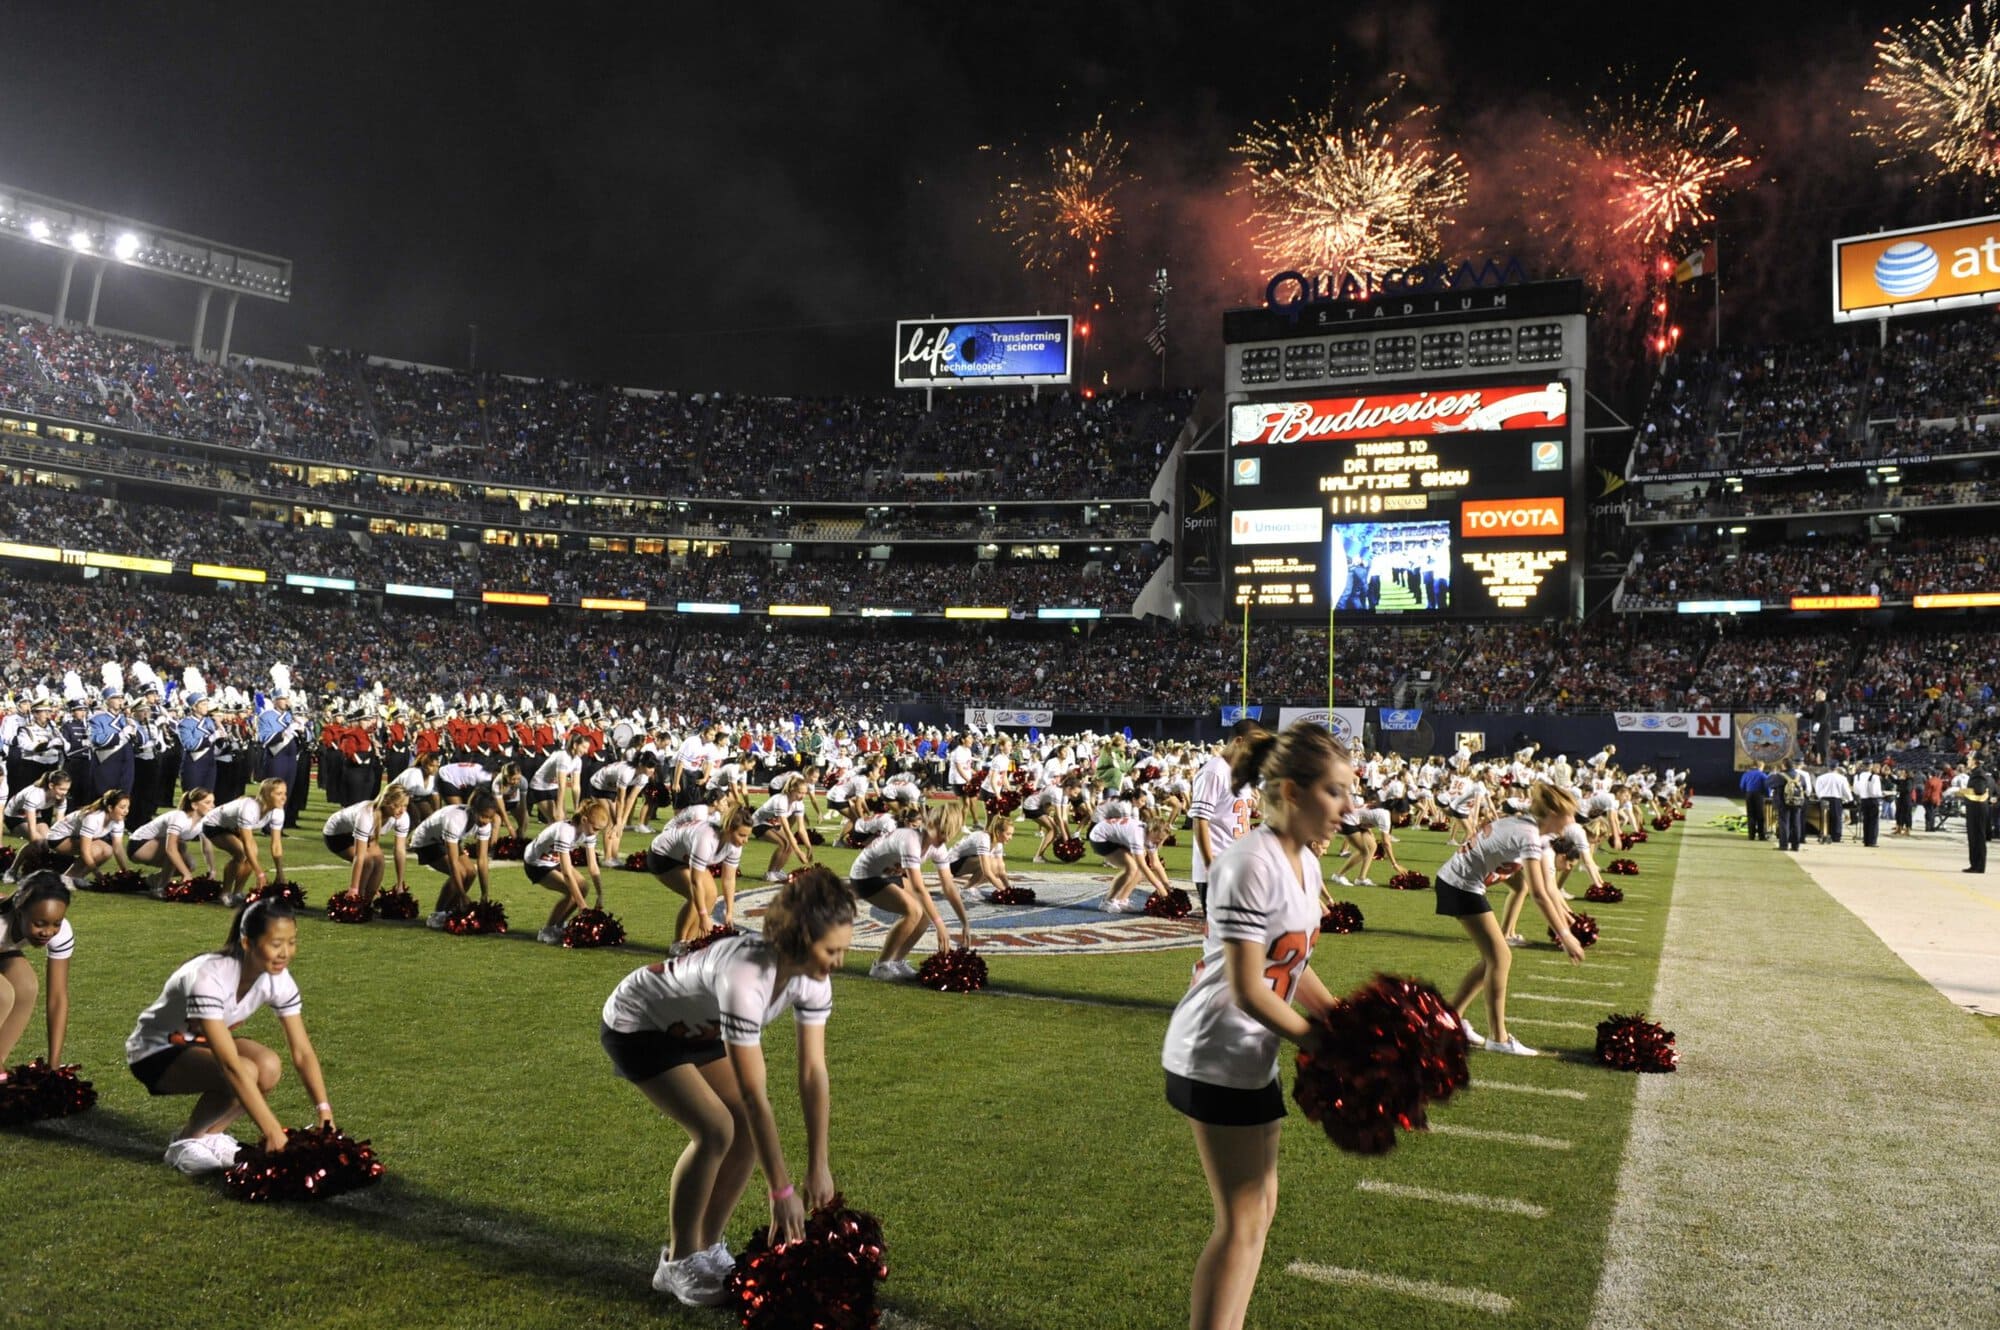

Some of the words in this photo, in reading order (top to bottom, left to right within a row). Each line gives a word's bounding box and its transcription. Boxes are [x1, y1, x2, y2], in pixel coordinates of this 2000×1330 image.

[1320, 295, 1506, 322] STADIUM
[992, 332, 1061, 344] Transforming
[1006, 342, 1045, 352] science
[900, 327, 957, 376] life
[940, 362, 1003, 373] technologies
[1261, 391, 1481, 444] Budweiser
[1355, 442, 1405, 456] THANKS
[1409, 440, 1428, 453] TO
[1344, 458, 1368, 473] DR
[1374, 455, 1438, 472] PEPPER
[1668, 472, 1697, 480] CONDUCT
[1723, 469, 1739, 477] TEXT
[1806, 463, 1825, 471] YOUR
[1827, 460, 1860, 469] OCATION
[1862, 459, 1877, 467] AND
[1878, 458, 1897, 466] ISSUE
[1320, 474, 1411, 491] HALFTIME
[1421, 470, 1469, 487] SHOW
[1466, 507, 1560, 528] TOYOTA
[1697, 716, 1721, 736] N
